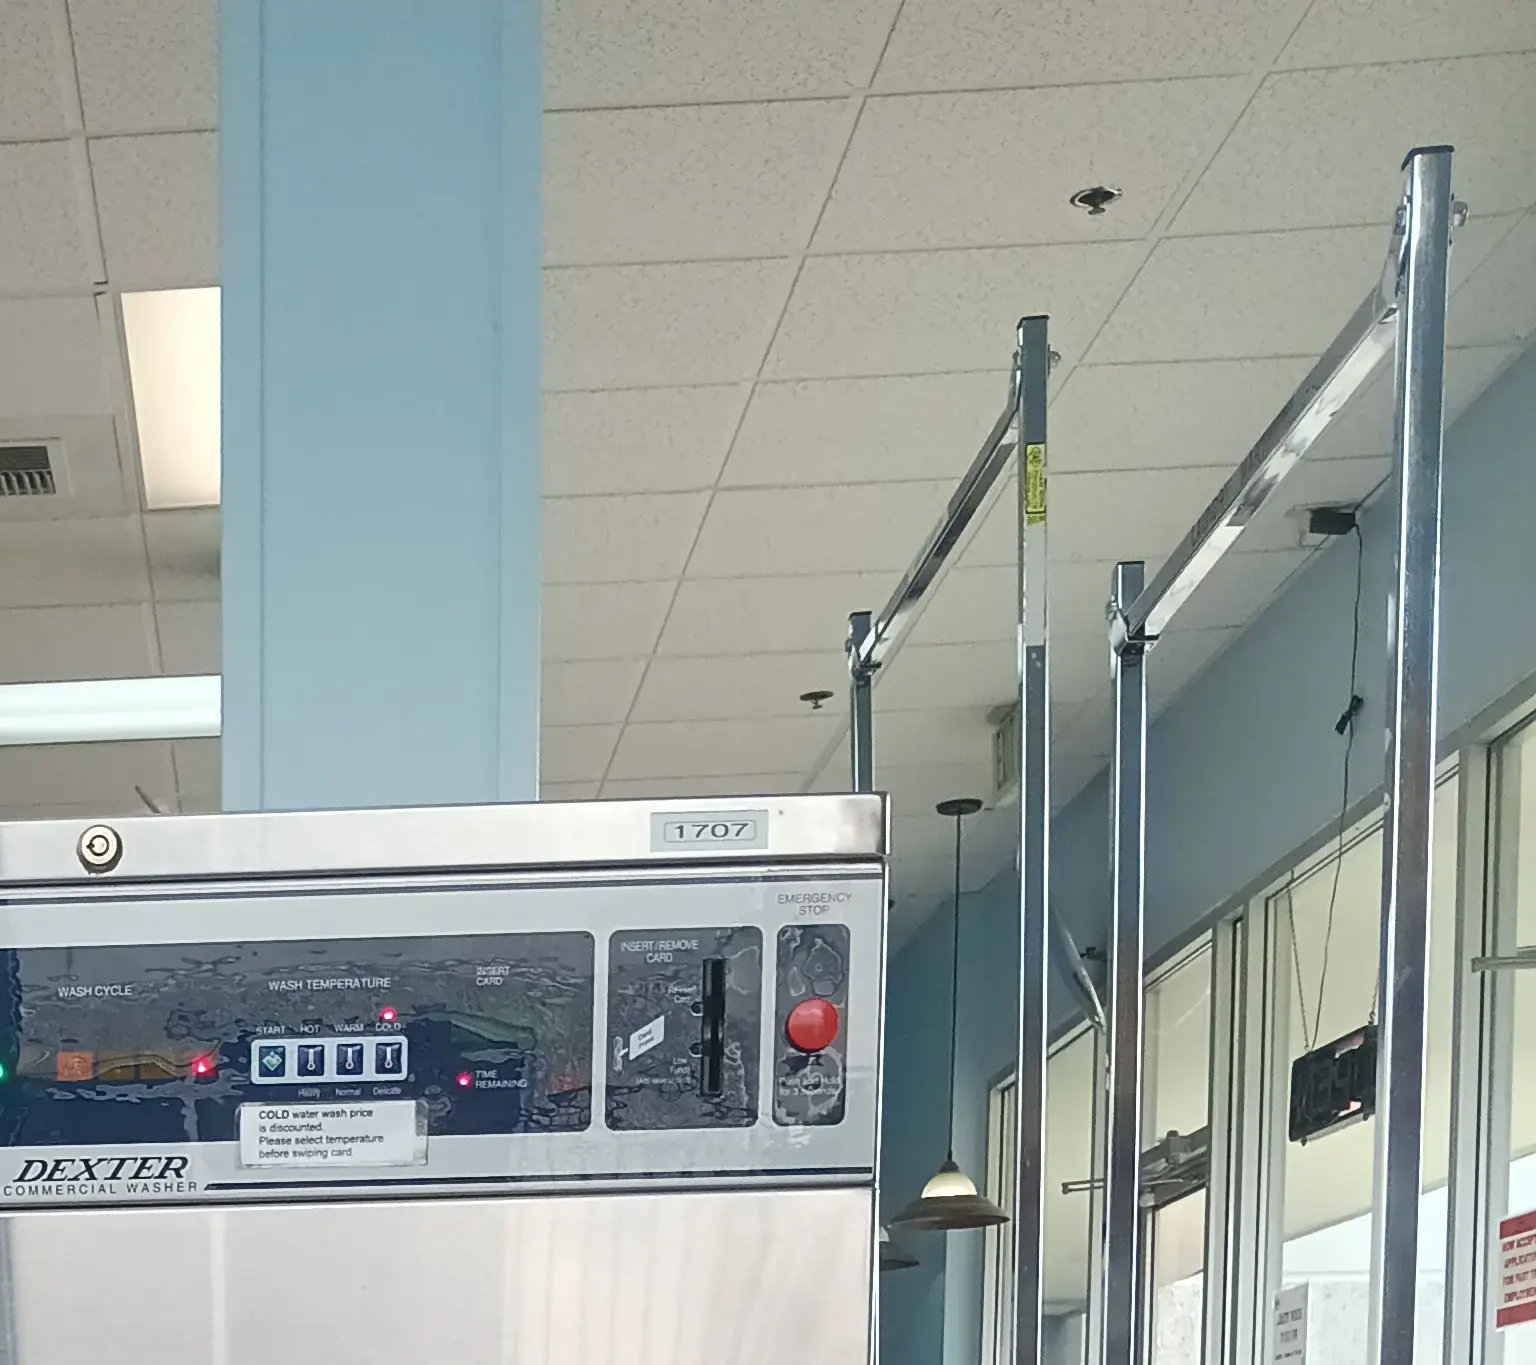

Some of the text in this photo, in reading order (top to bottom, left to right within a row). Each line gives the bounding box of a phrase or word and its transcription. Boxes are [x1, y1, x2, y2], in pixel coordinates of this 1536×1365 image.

[675, 822, 749, 839] 1707
[777, 892, 852, 905] EMERGENCY
[798, 904, 830, 916] STOP
[646, 952, 674, 963] CARD
[476, 965, 511, 976] INSERT
[268, 977, 392, 992] WASH TEMPERATURE
[476, 976, 504, 986] CARD
[58, 985, 133, 998] WASH CYCLE
[299, 1024, 321, 1034] HOT
[475, 1070, 498, 1079] TIME
[475, 1079, 528, 1089] REMAINING
[258, 1108, 374, 1120] COLD water wash price
[259, 1124, 267, 1133] is
[259, 1134, 385, 1145] Please select temperature
[258, 1149, 290, 1159] before
[292, 1148, 328, 1160] swiping
[12, 1156, 189, 1183] DEXTER
[3, 1181, 198, 1196] COMMERCIAL WASHER
